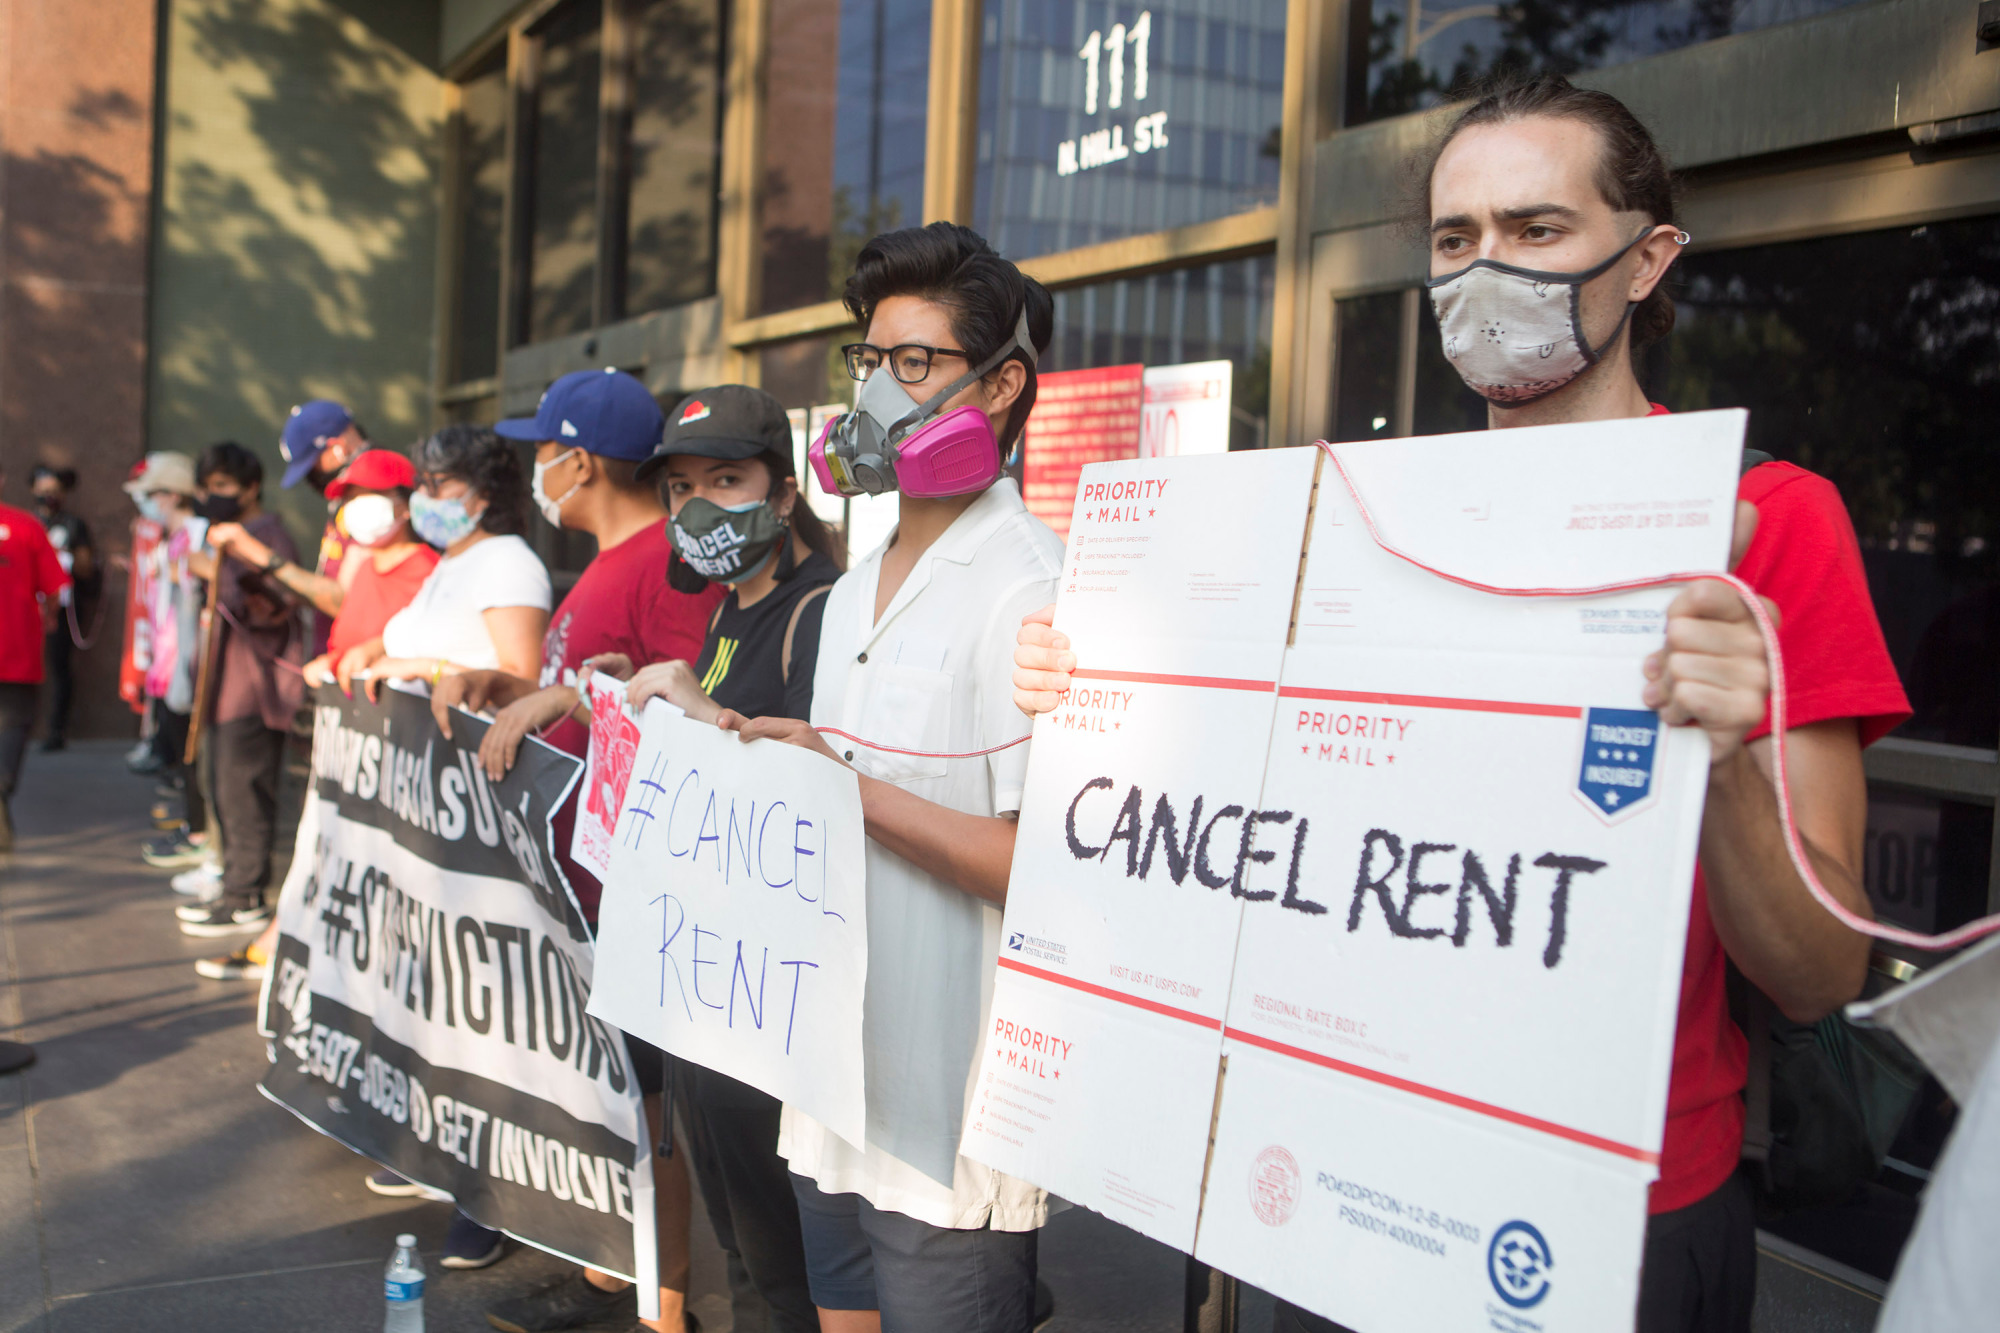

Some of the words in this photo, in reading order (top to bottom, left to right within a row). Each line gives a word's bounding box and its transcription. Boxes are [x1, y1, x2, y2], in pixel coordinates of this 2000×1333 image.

[1079, 10, 1151, 115] 111
[1080, 125, 1129, 170] HILL
[1083, 479, 1168, 502] PRIORITY
[1098, 506, 1140, 523] MAIL
[1059, 688, 1133, 711] RIORITY
[1064, 714, 1106, 733] MAIL
[1297, 711, 1411, 742] PRIORITY
[1590, 724, 1653, 747] TRACKED
[1318, 743, 1375, 766] MAIL
[1584, 764, 1646, 788] INSURED
[624, 751, 846, 923] #CANCEL
[1065, 776, 1328, 915] CANCEL
[1347, 828, 1608, 969] RENT
[1023, 946, 1042, 958] POSTAL
[1026, 935, 1046, 947] UNITED
[1047, 941, 1067, 952] STATES
[649, 893, 819, 1055] RENT
[1109, 964, 1130, 979] VISIT
[1130, 969, 1142, 983] US
[1144, 974, 1154, 986] AT
[1253, 994, 1302, 1020] REGIONAL
[1305, 1008, 1333, 1028] RATE
[1335, 1016, 1358, 1034] BOX
[1359, 1023, 1368, 1038] C
[995, 1018, 1072, 1061] PRIORITY
[1006, 1050, 1046, 1079] MAIL
